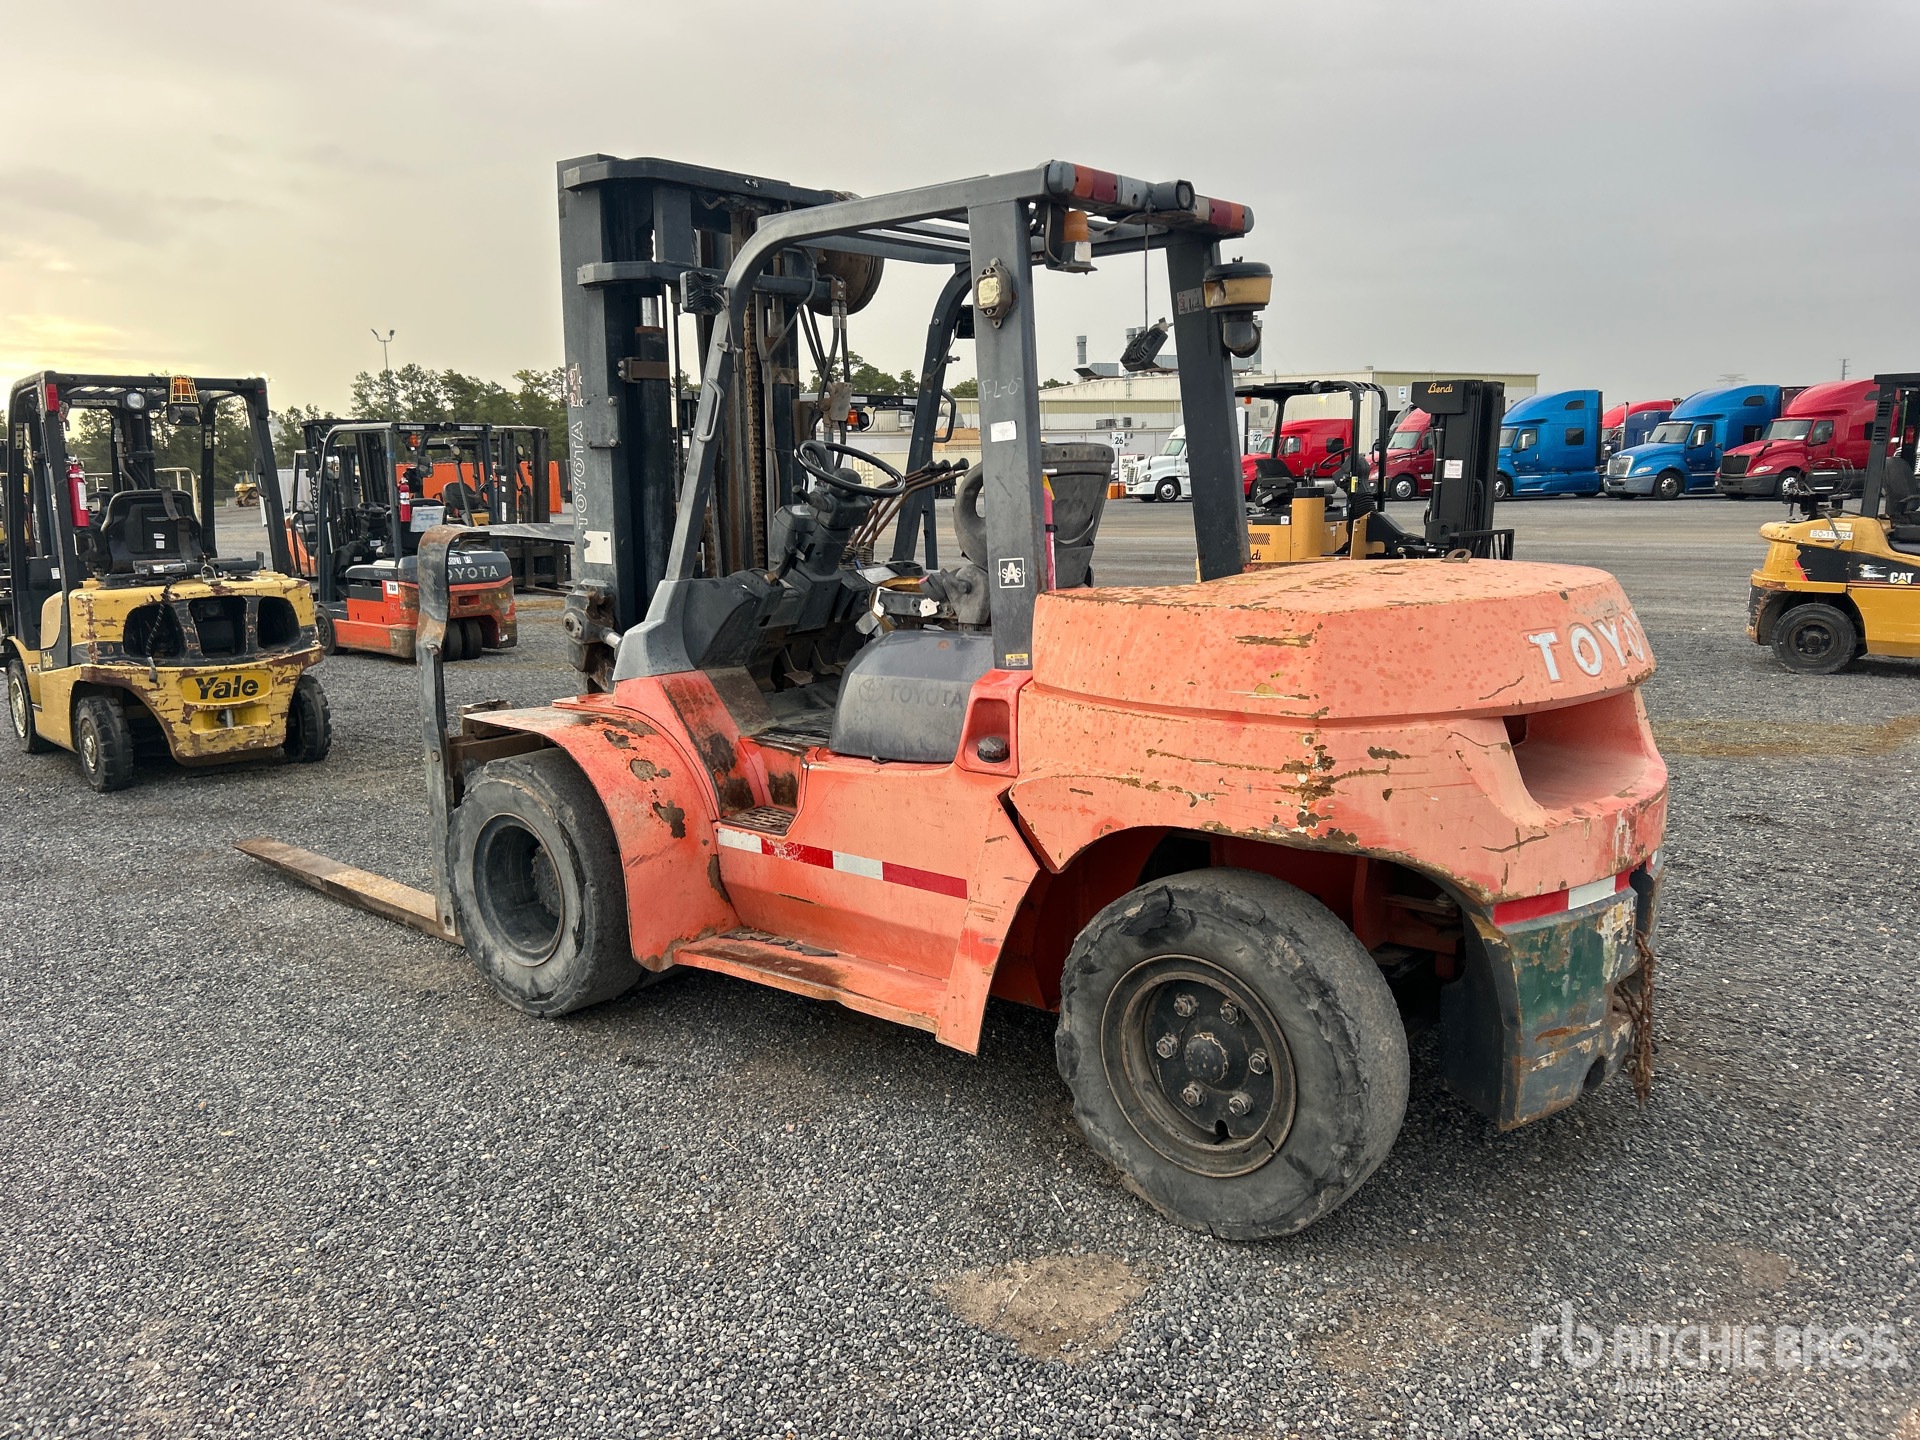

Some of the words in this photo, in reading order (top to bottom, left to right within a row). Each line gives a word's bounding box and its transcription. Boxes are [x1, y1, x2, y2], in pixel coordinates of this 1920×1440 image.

[1428, 382, 1453, 393] Bendi
[1115, 436, 1124, 445] 26
[1253, 433, 1262, 442] 27
[571, 421, 588, 530] TOYOTA
[310, 476, 319, 515] TOYOTA
[1890, 571, 1915, 585] CAT
[1528, 611, 1645, 681] TOYO
[195, 675, 259, 700] Yale
[889, 684, 964, 710] TOYOTA
